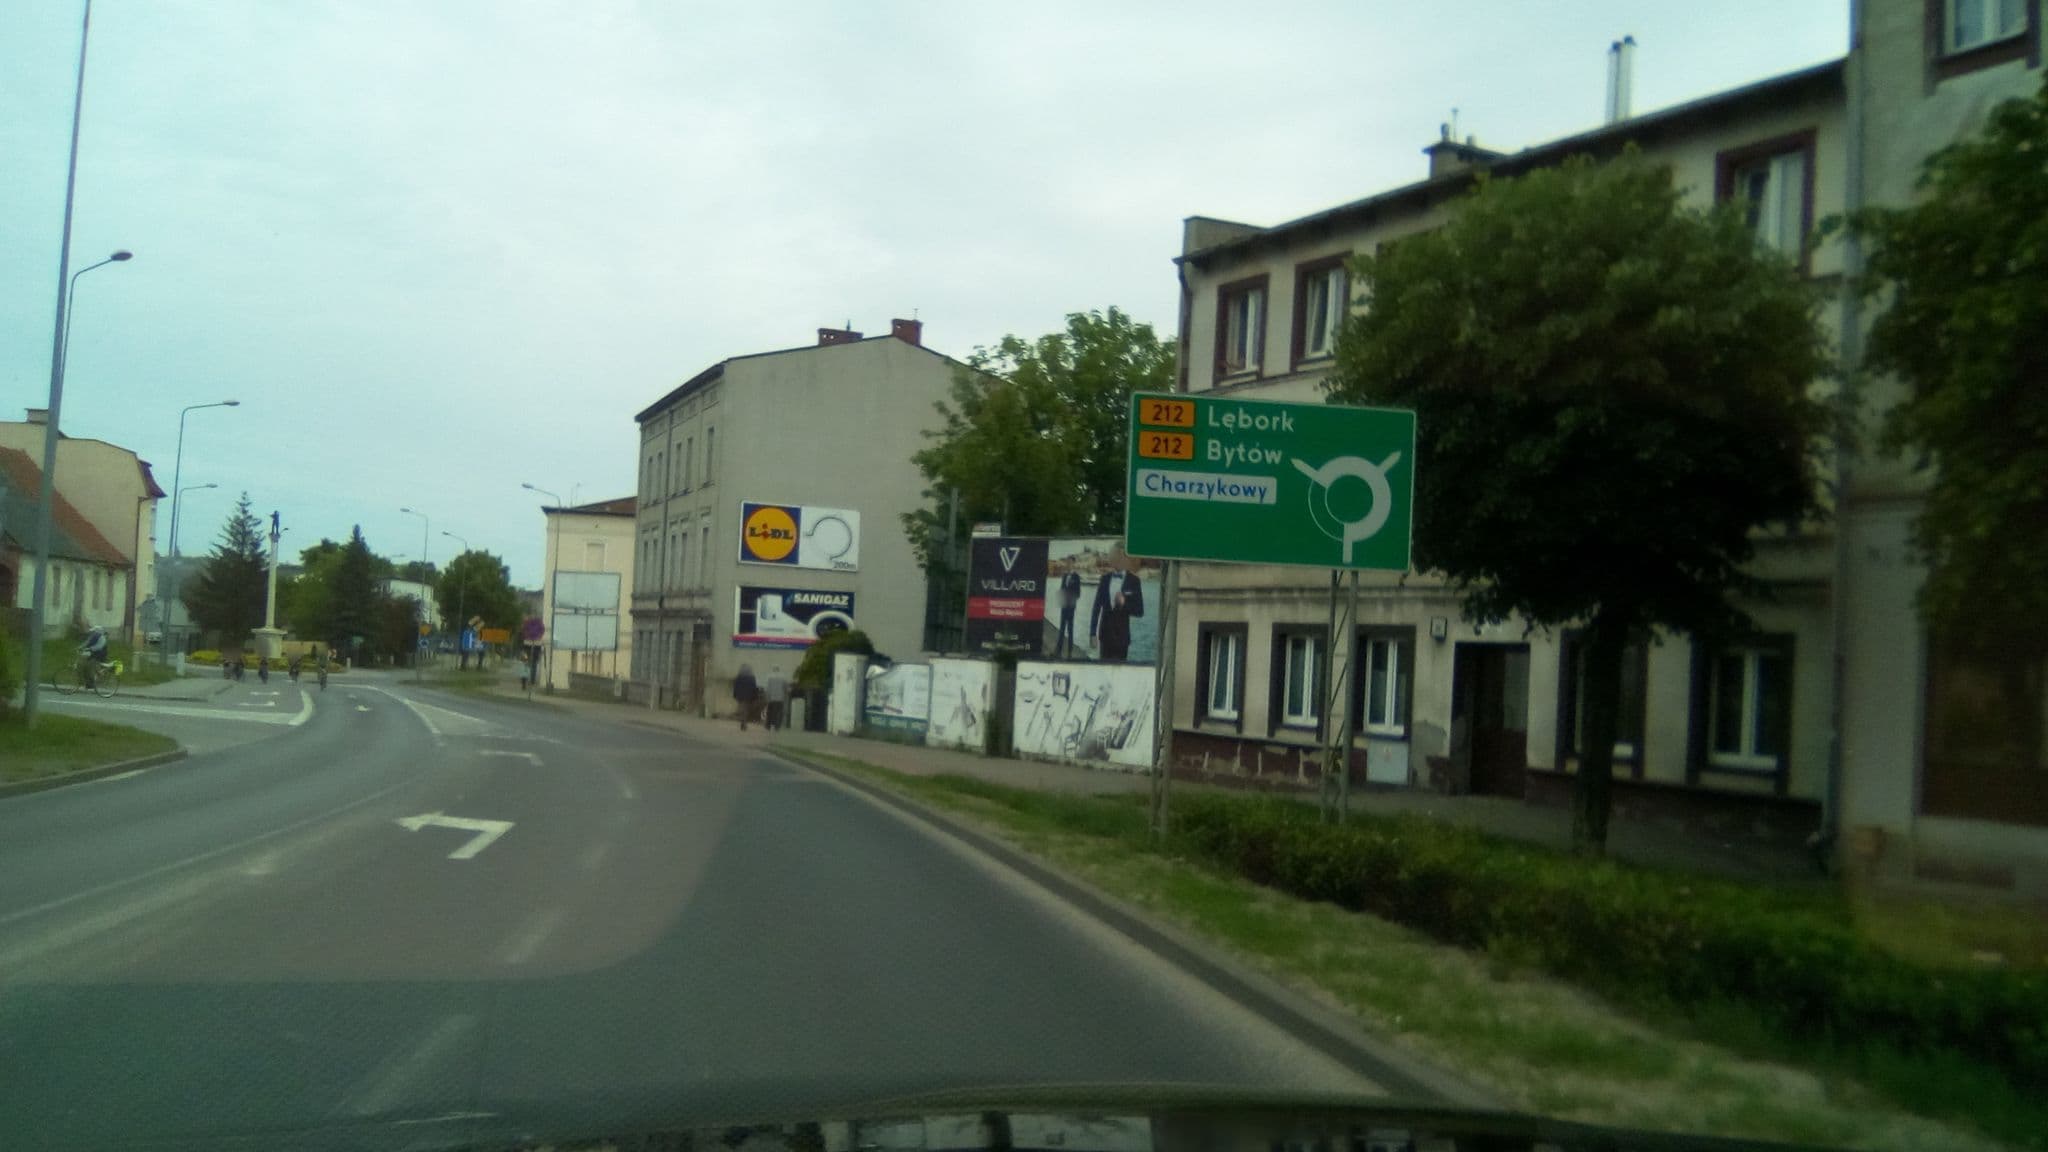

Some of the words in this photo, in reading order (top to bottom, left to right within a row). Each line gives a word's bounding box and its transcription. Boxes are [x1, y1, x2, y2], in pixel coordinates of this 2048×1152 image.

[1152, 403, 1184, 422] 212
[1207, 405, 1294, 433] Lębork
[1151, 436, 1182, 454] 212
[1207, 440, 1283, 467] Bytów
[1144, 473, 1268, 501] Charzykowy
[981, 578, 1036, 591] VILLARD
[793, 592, 849, 606] SANIGAZ
